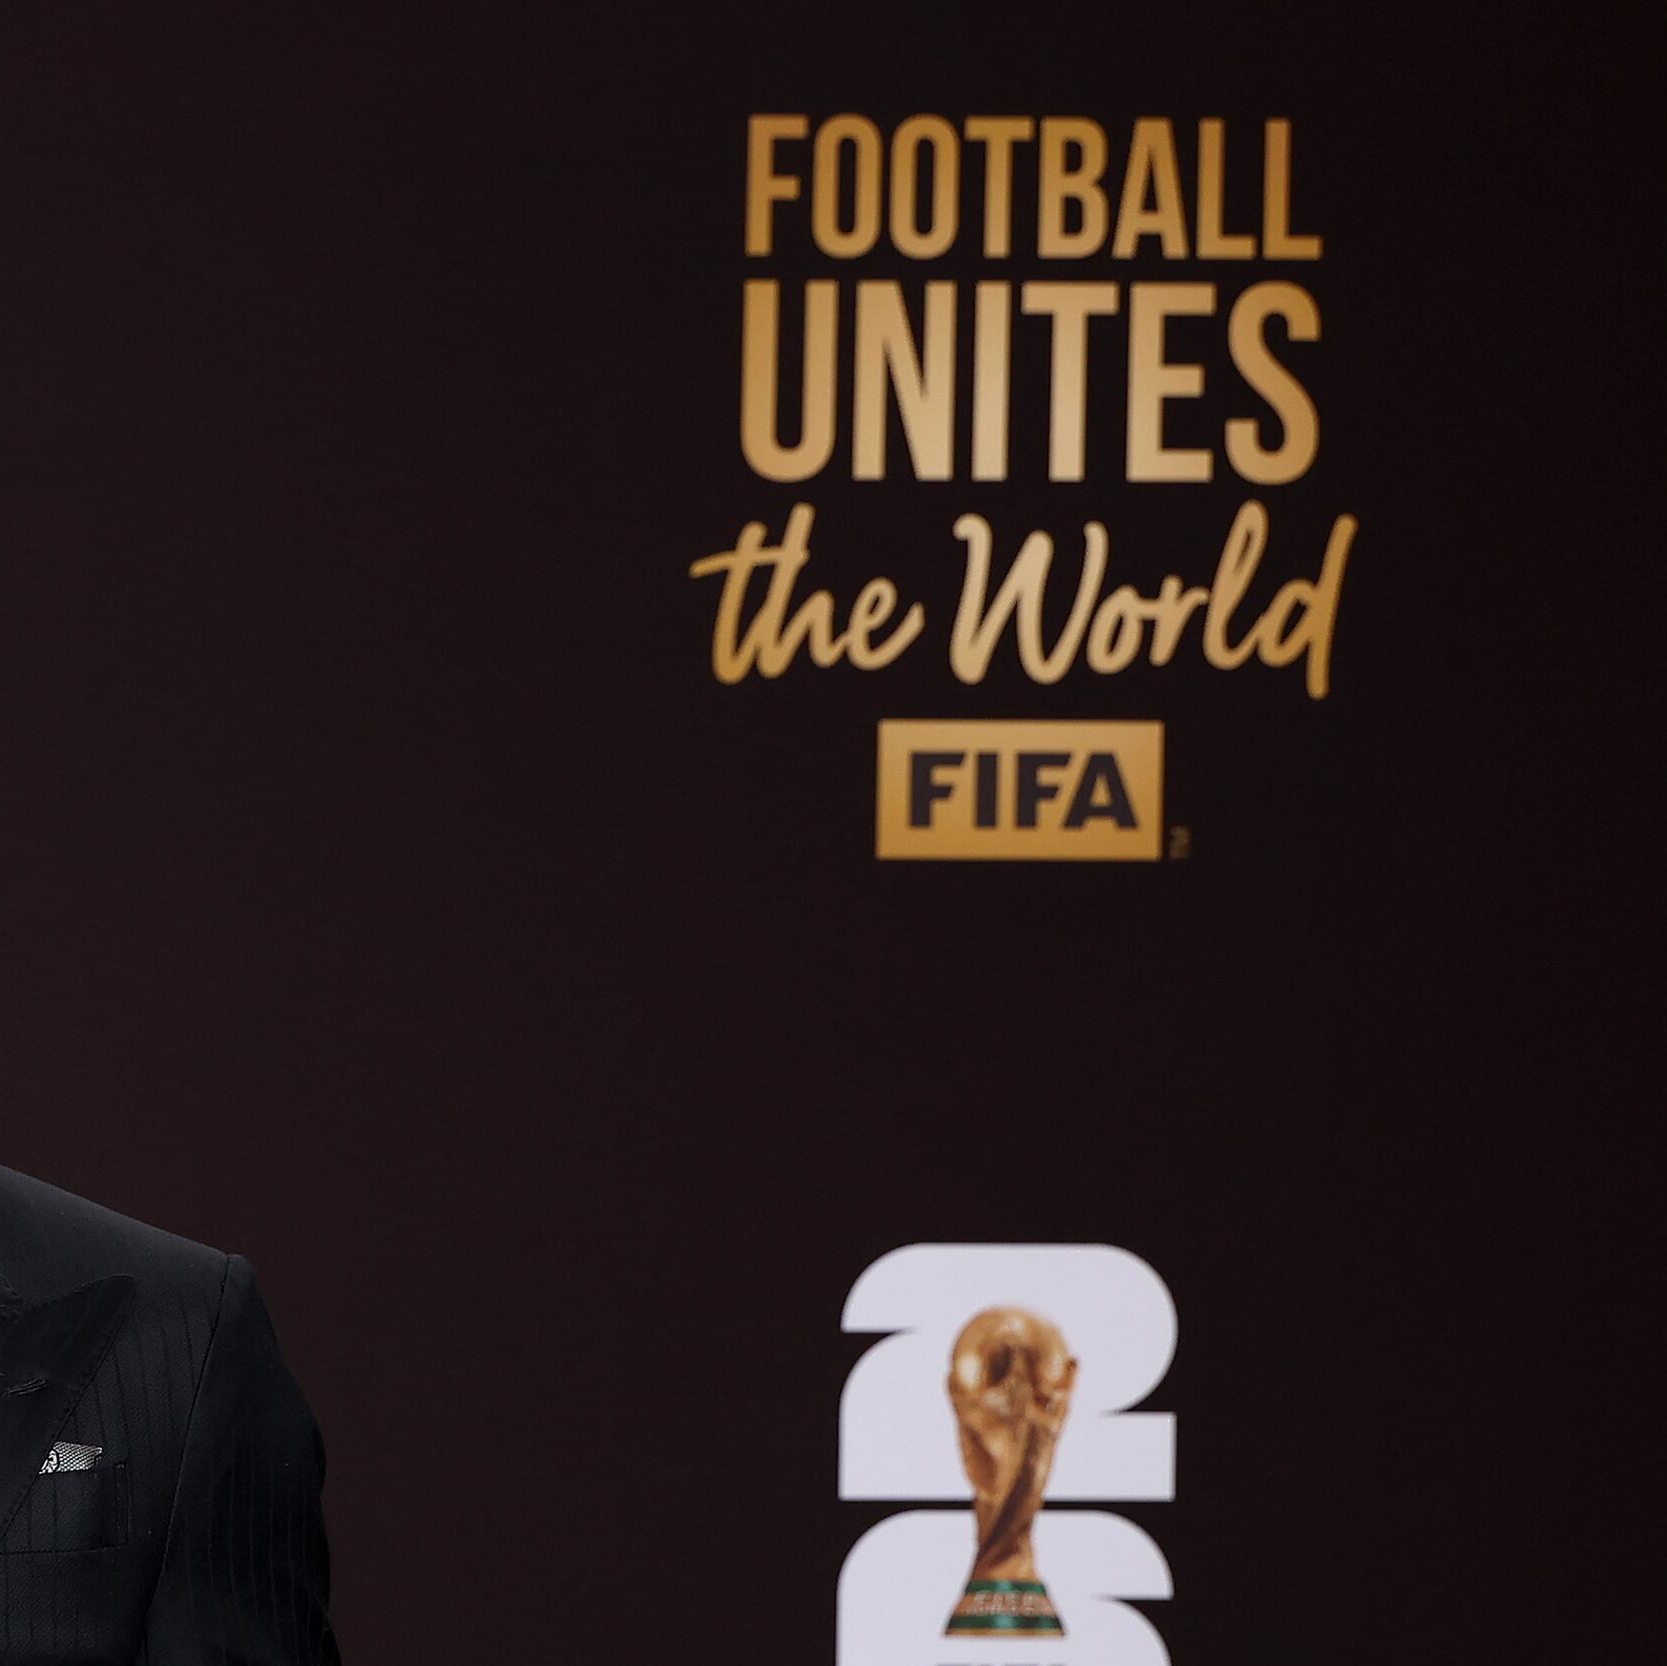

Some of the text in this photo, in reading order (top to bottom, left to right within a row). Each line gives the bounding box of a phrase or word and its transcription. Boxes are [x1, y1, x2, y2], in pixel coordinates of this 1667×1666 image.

[746, 115, 1322, 259] FOOTBALL
[742, 280, 1319, 484] UNITES
[691, 502, 1356, 697] the World
[909, 752, 1138, 829] FIFA
